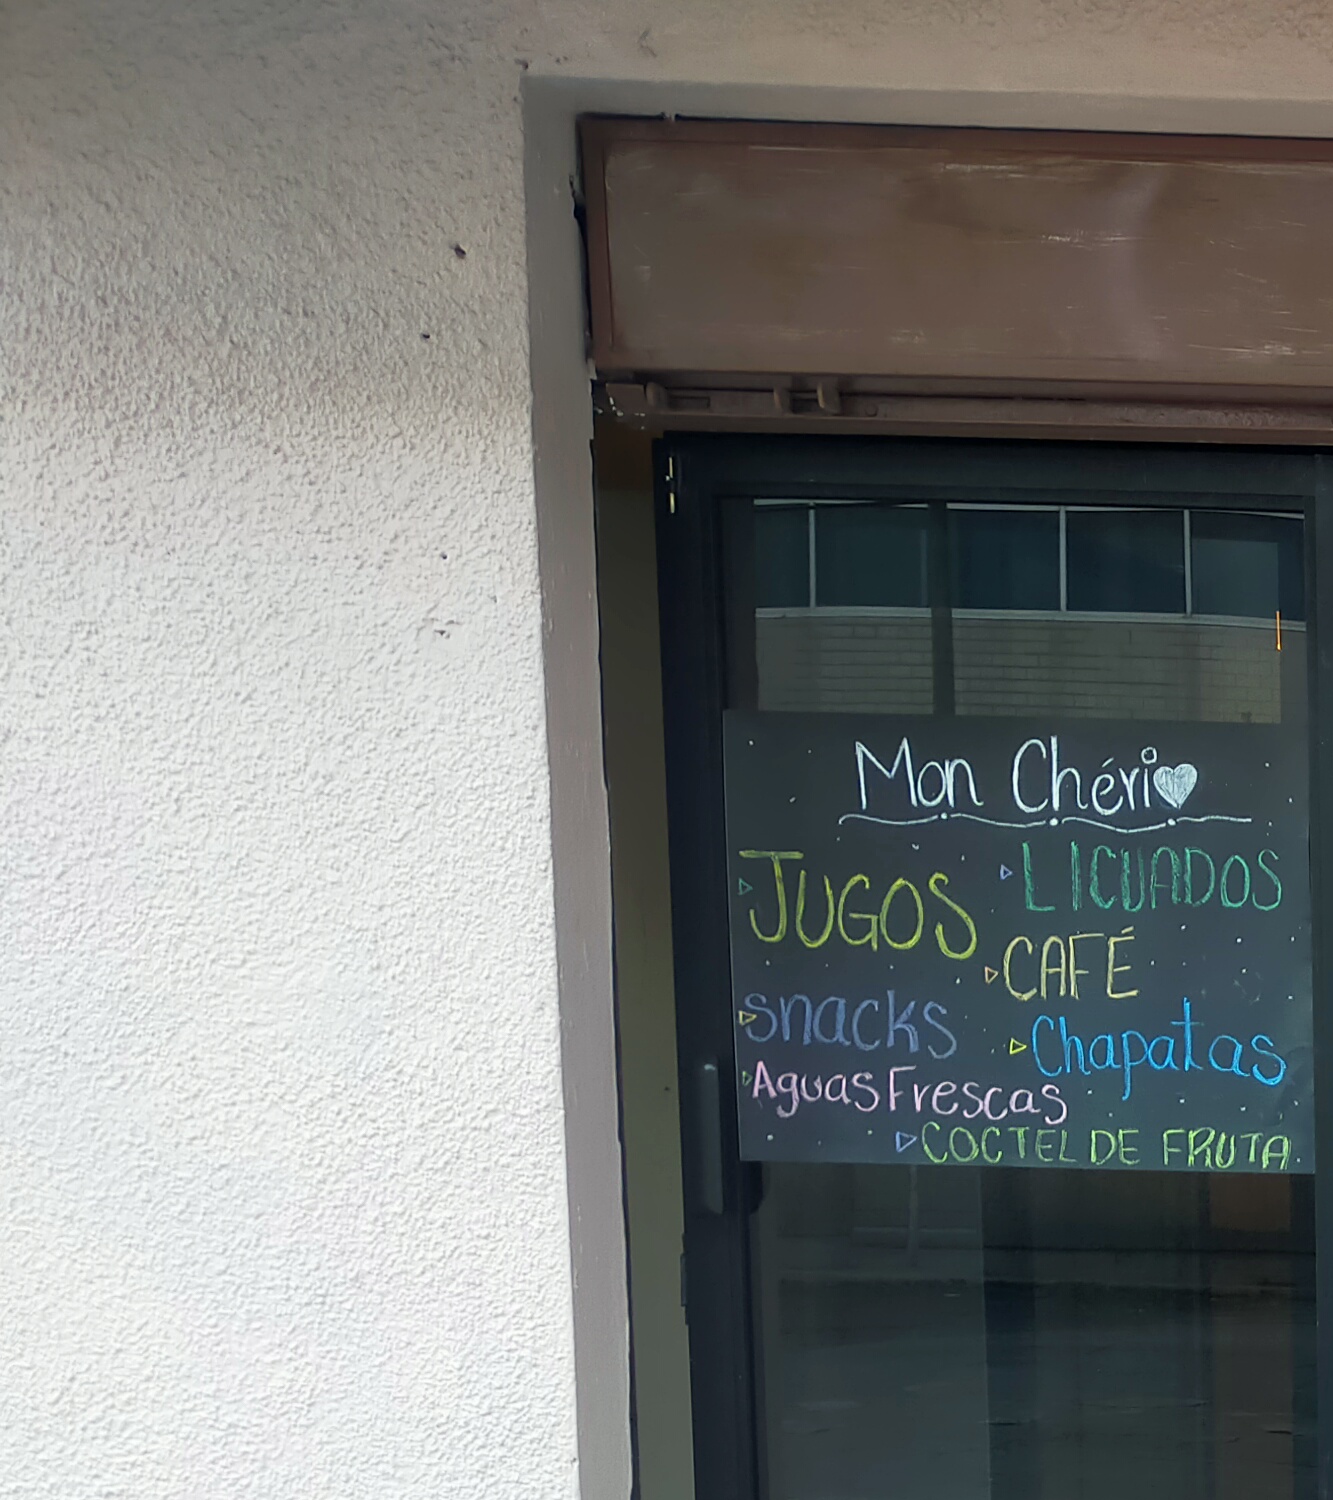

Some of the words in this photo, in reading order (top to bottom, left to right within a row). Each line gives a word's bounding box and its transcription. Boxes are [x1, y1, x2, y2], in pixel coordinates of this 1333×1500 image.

[853, 736, 983, 811] Mon
[1010, 735, 1156, 816] Chéri
[739, 850, 978, 960] JUGOS
[1020, 841, 1284, 912] LICUADOS
[1003, 925, 1139, 1000] CAFÉ
[1031, 997, 1287, 1100] Chapatas
[920, 1121, 1076, 1165] COCTEL
[1090, 1128, 1140, 1167] DE
[1162, 1127, 1293, 1170] FRUTA
